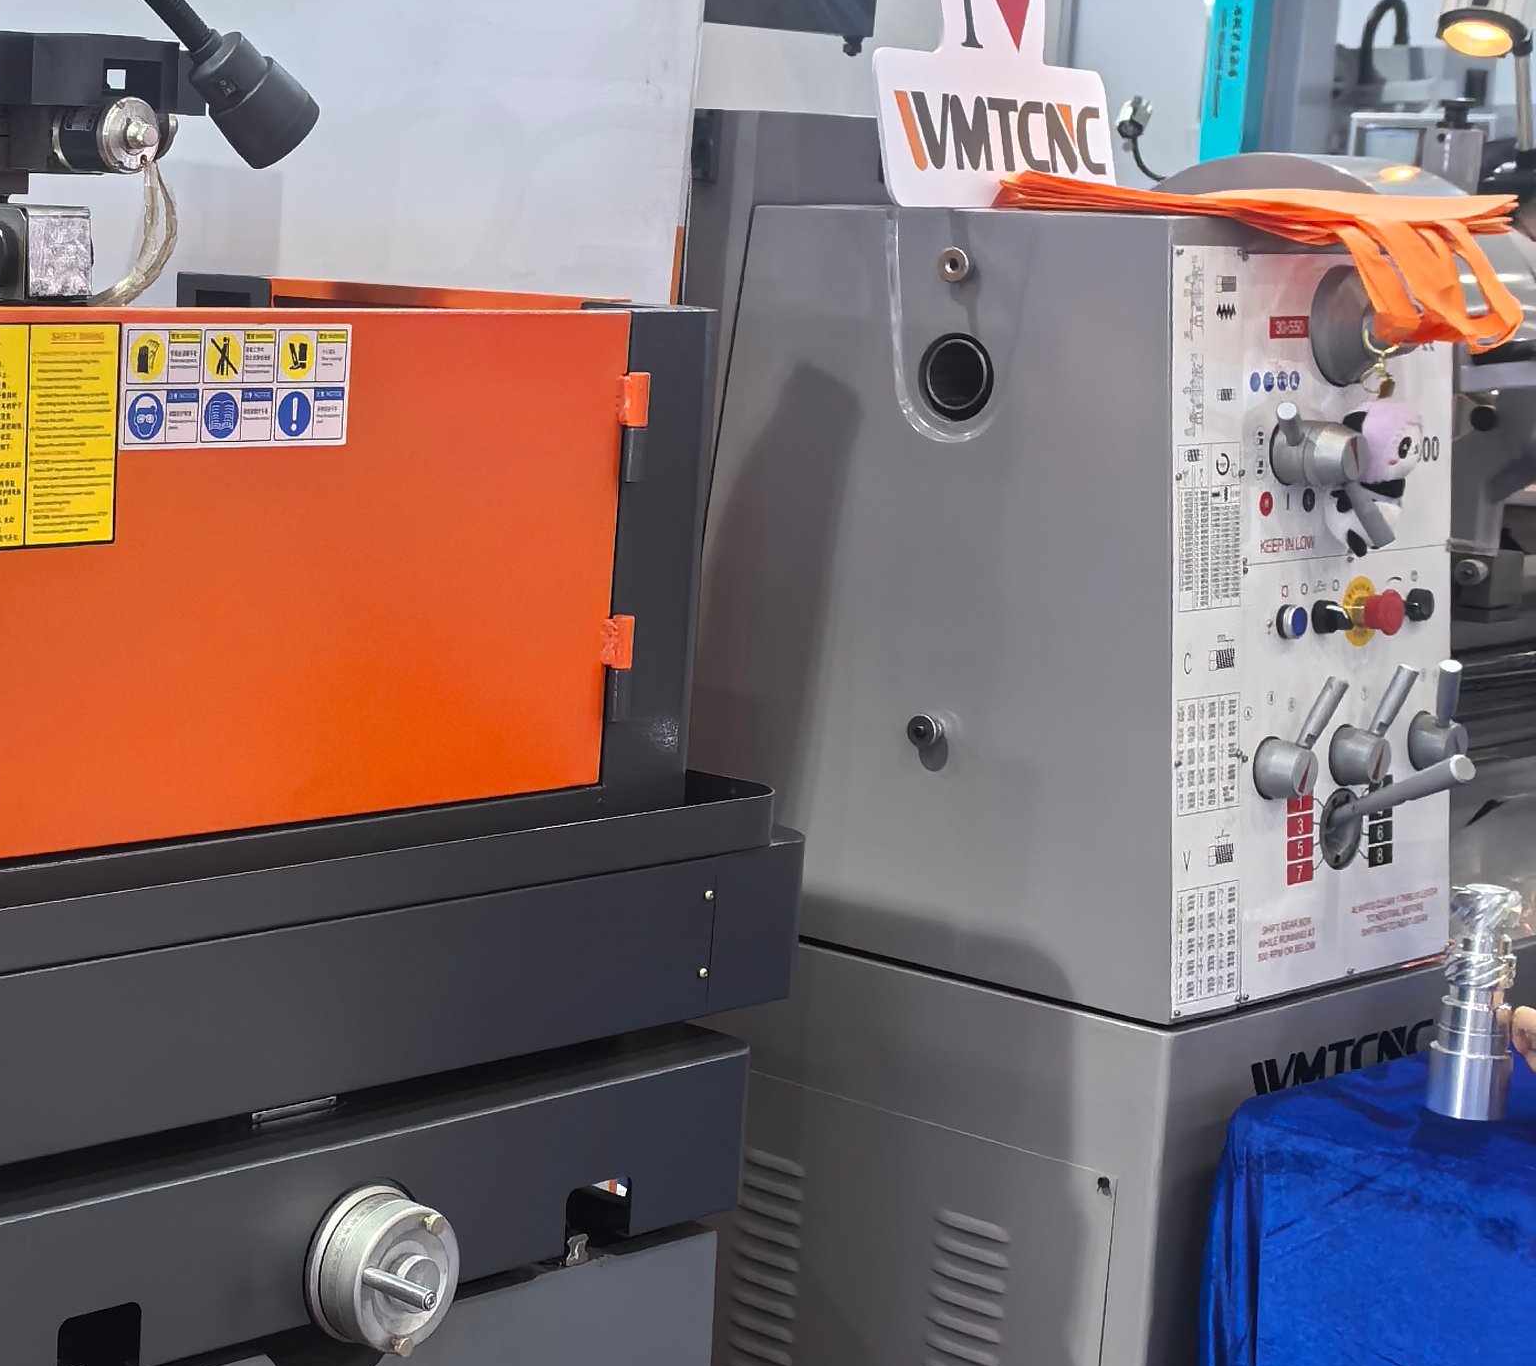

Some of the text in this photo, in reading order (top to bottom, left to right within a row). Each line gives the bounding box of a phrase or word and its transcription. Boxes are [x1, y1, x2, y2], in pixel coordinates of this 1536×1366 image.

[1260, 537, 1285, 555] KEEP
[1297, 818, 1304, 835] 3
[1377, 825, 1384, 841] 6
[1297, 839, 1304, 857] 5
[1377, 847, 1384, 864] 8
[1296, 865, 1303, 881] 7
